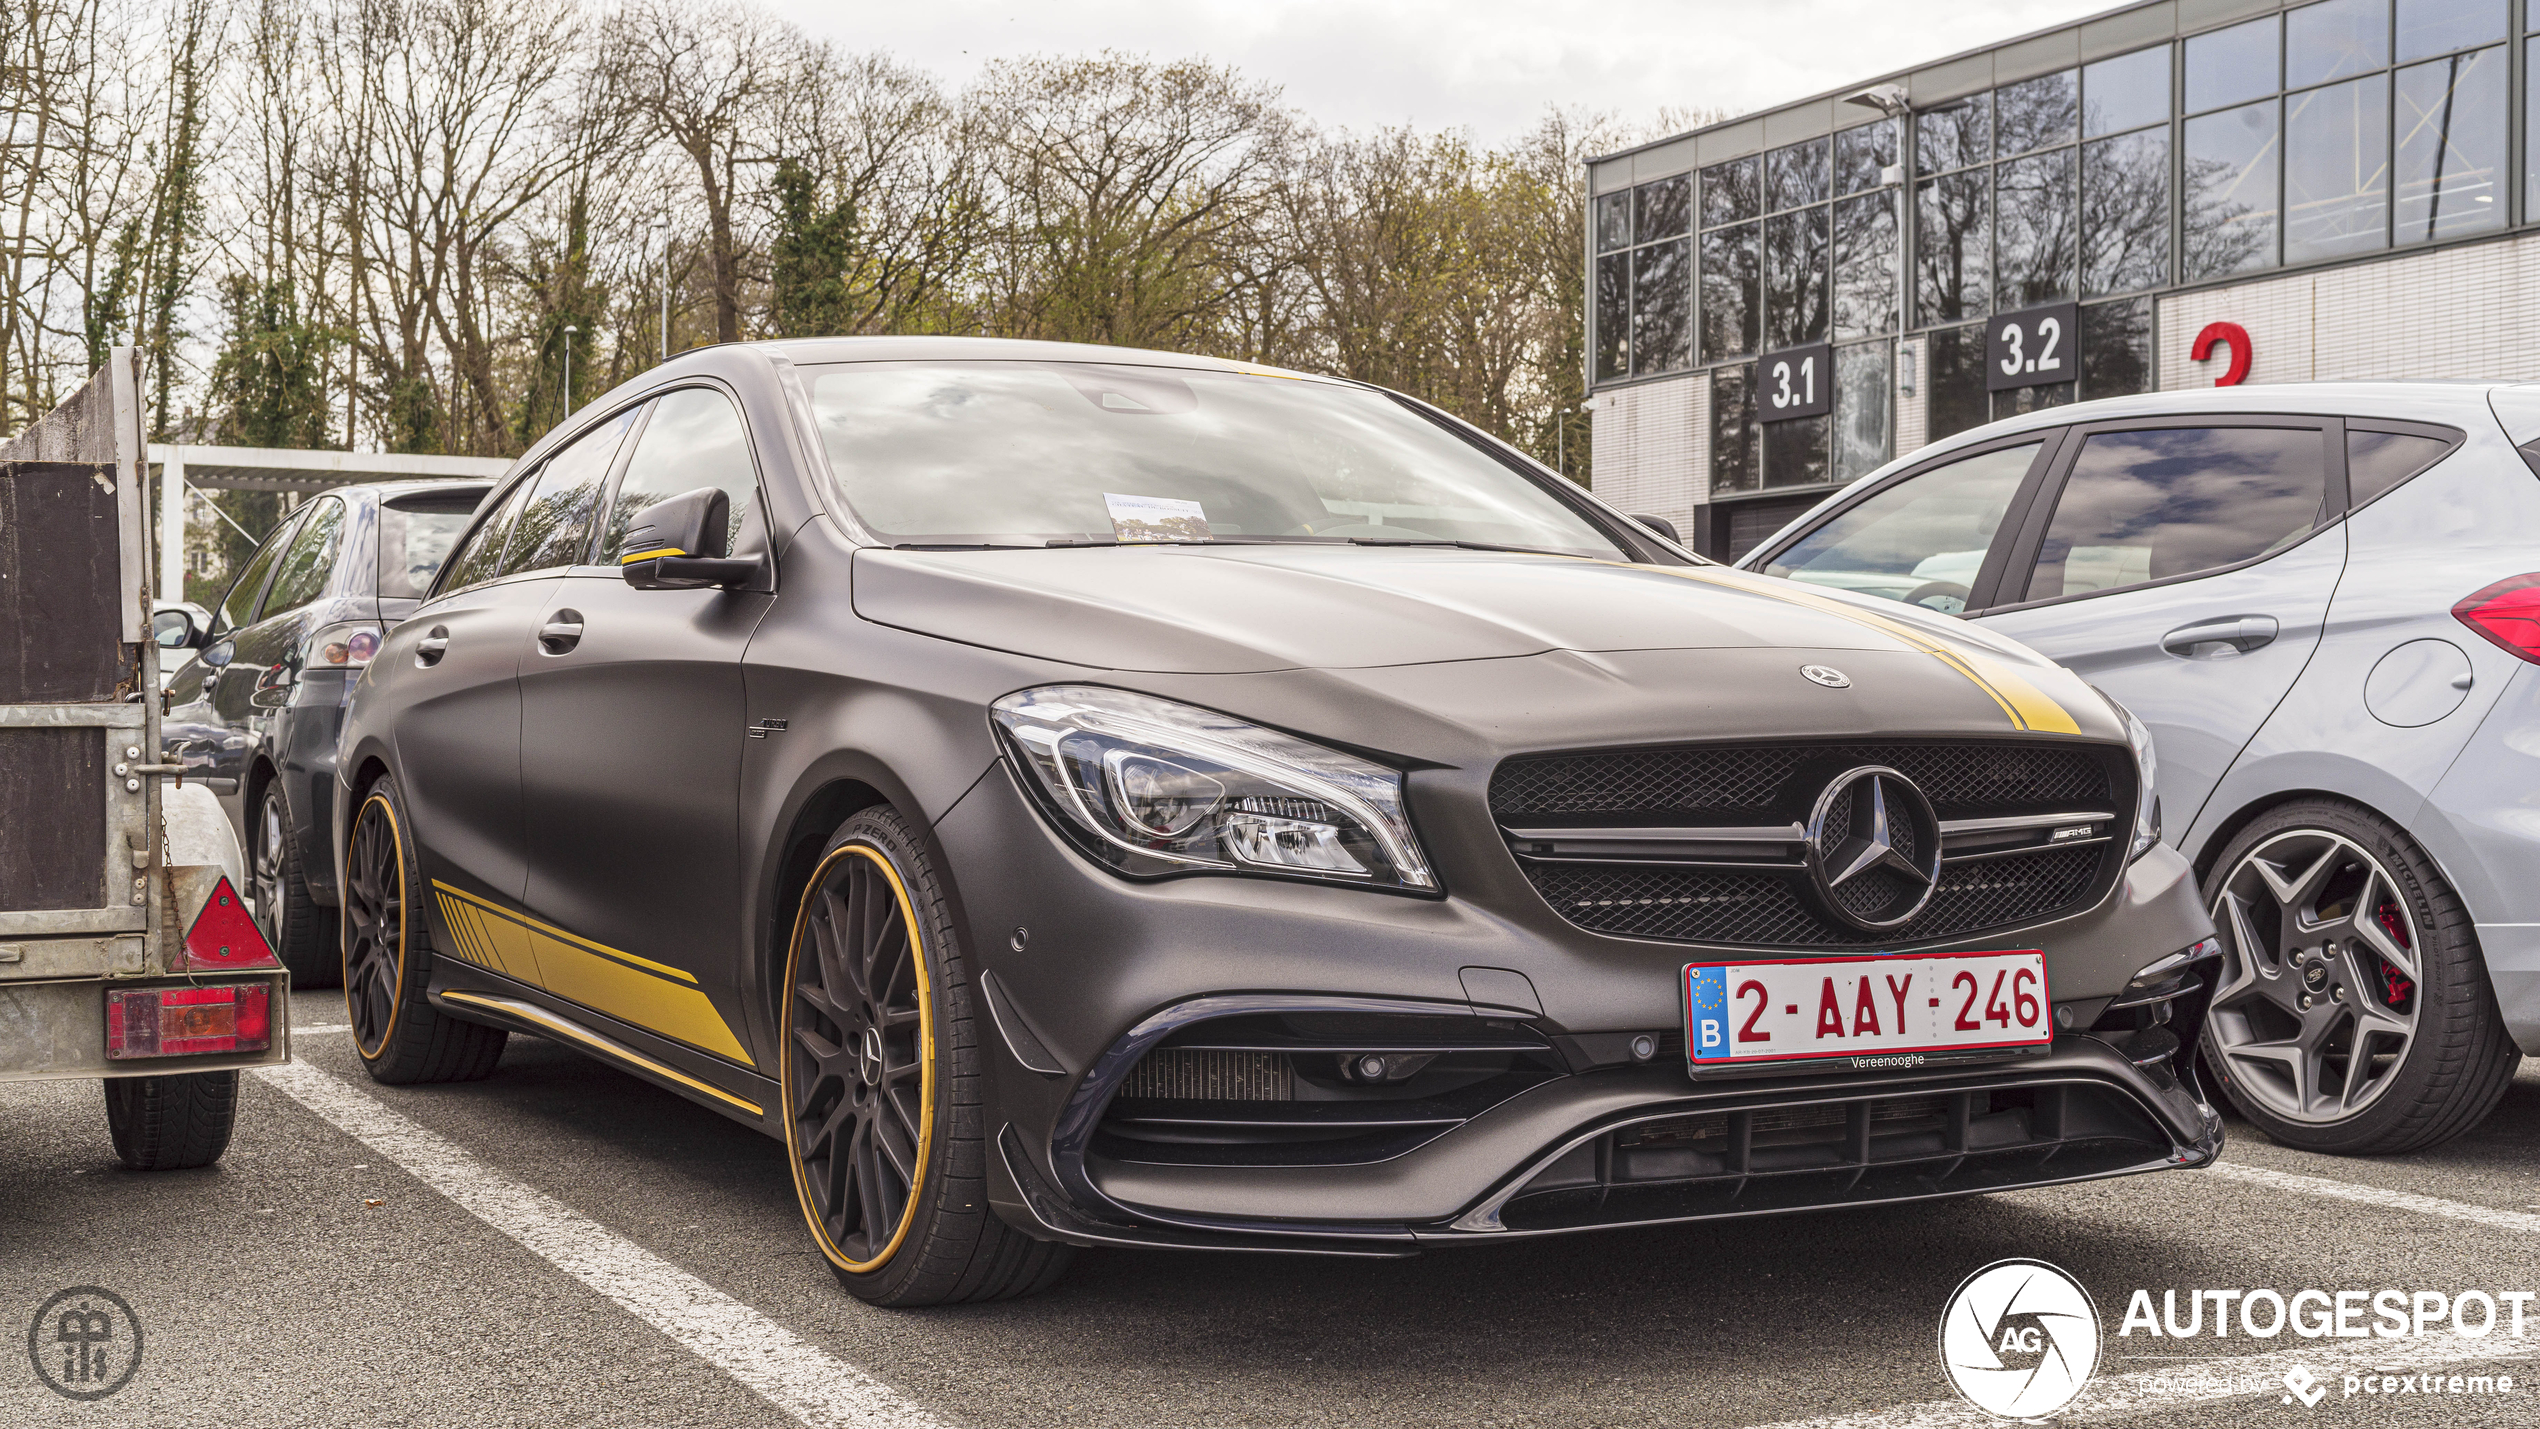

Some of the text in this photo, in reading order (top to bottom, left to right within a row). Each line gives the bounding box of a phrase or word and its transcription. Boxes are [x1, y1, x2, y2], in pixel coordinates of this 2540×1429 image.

[2000, 317, 2061, 376] 3.2
[1772, 356, 1814, 408] 3.1
[852, 824, 898, 853] P ZERO
[2391, 853, 2433, 925] MICHELIN
[1701, 1019, 1721, 1048] B
[1851, 1054, 1924, 1069] Vereenooghe
